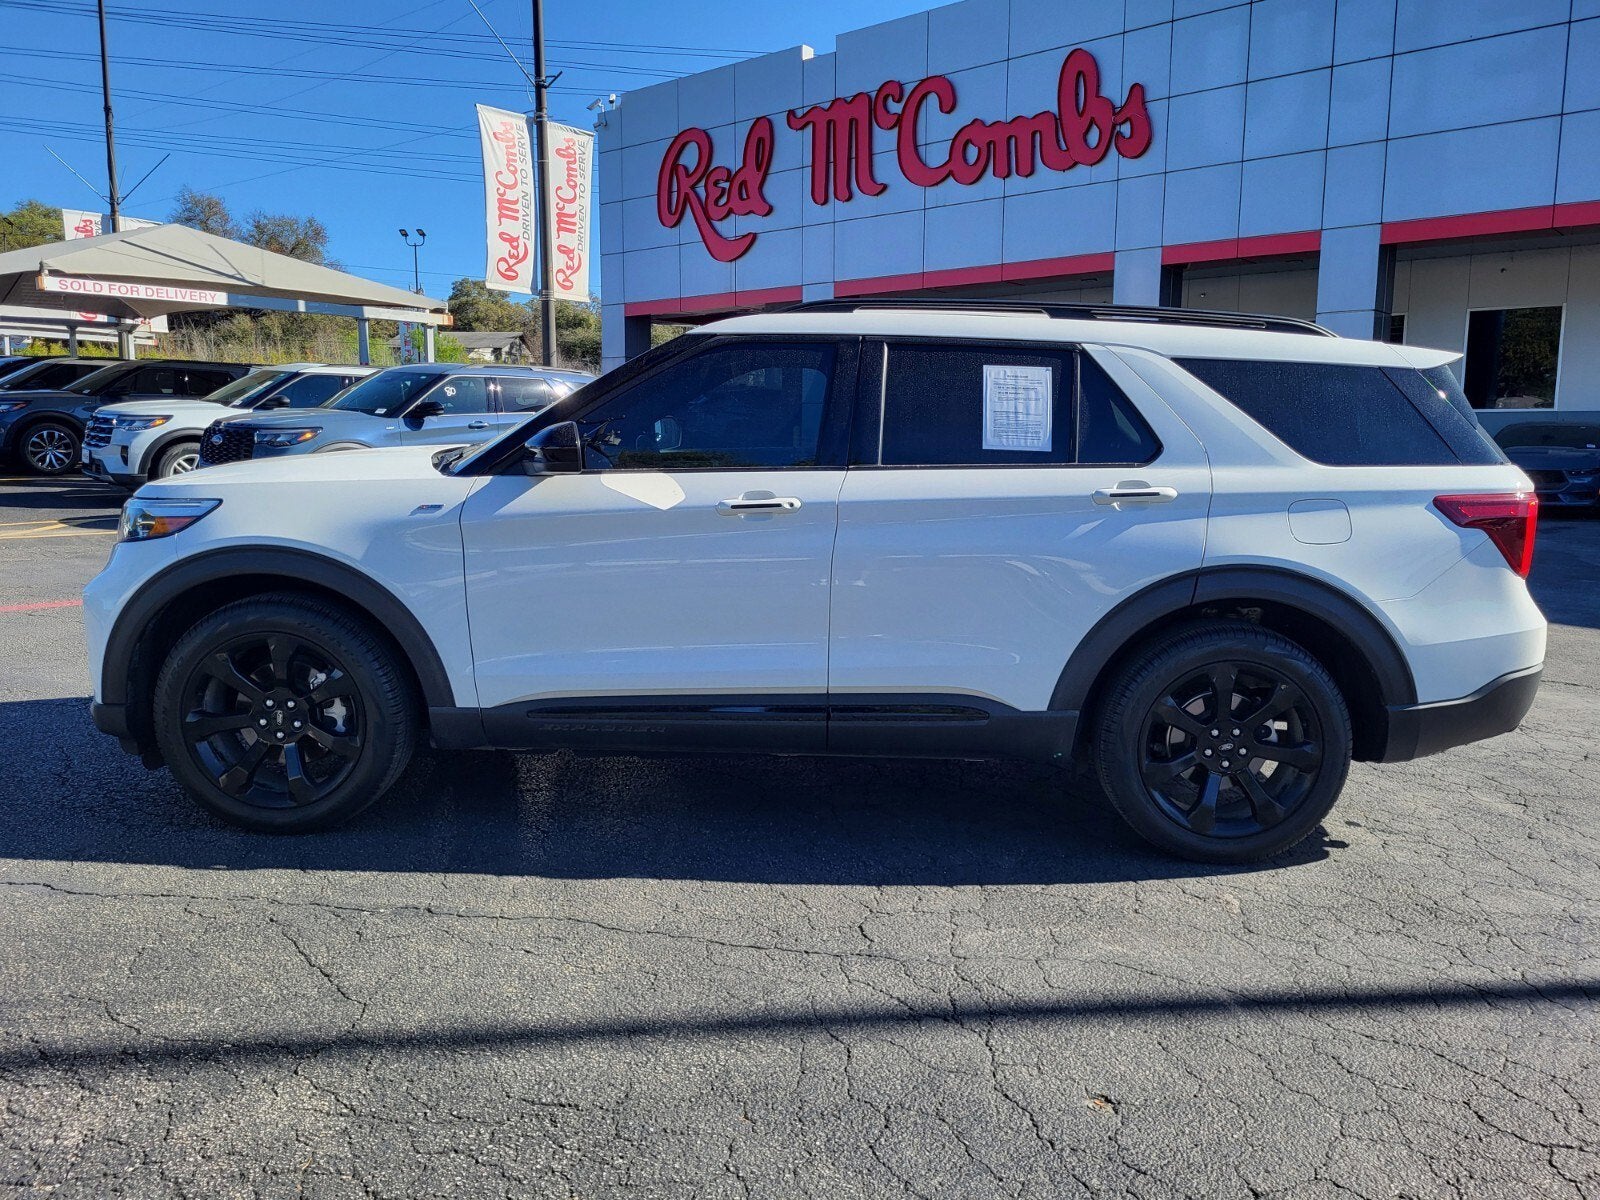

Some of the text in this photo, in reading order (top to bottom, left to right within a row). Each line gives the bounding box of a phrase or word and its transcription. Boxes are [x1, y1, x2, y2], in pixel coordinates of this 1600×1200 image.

[492, 121, 529, 282] Red McCombs
[518, 123, 532, 242] DRIVEN TO SERVE
[554, 137, 582, 291] Red McCombs
[577, 139, 588, 253] DRIVEN TO SERVE
[657, 48, 1153, 263] Red McCombs
[58, 279, 218, 303] SOLD FOR DELIVERY
